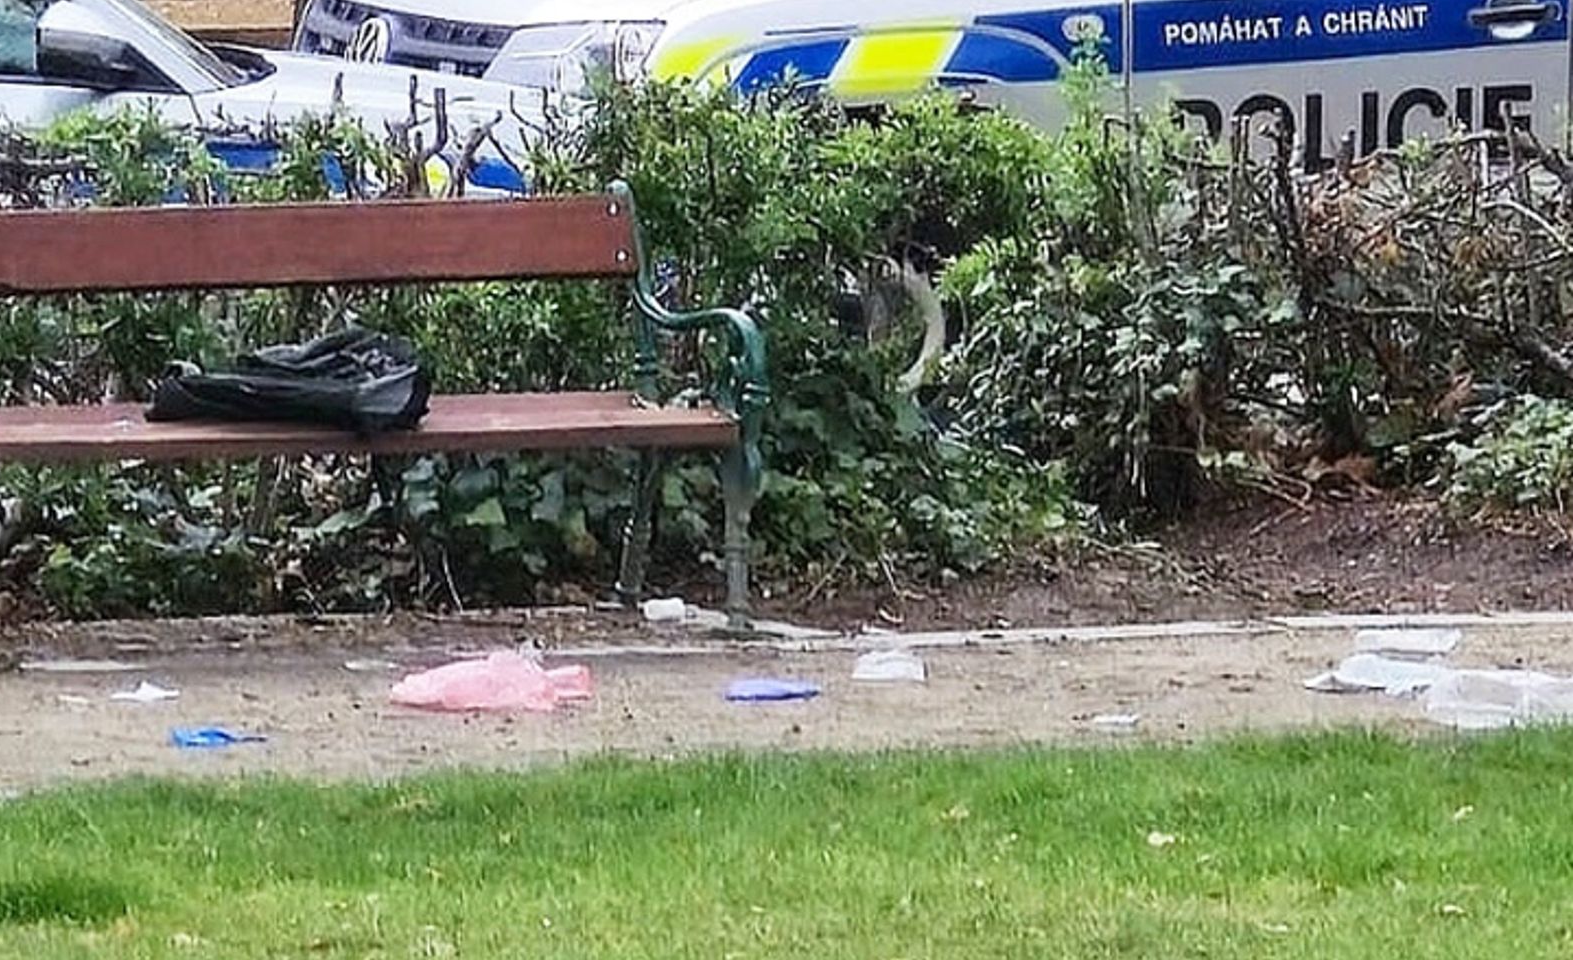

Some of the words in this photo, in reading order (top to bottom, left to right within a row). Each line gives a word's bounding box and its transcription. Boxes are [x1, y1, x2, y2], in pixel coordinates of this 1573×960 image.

[1164, 14, 1283, 46] POMÁHAT
[1295, 15, 1312, 37] A
[1324, 4, 1428, 35] CHRÁNIT
